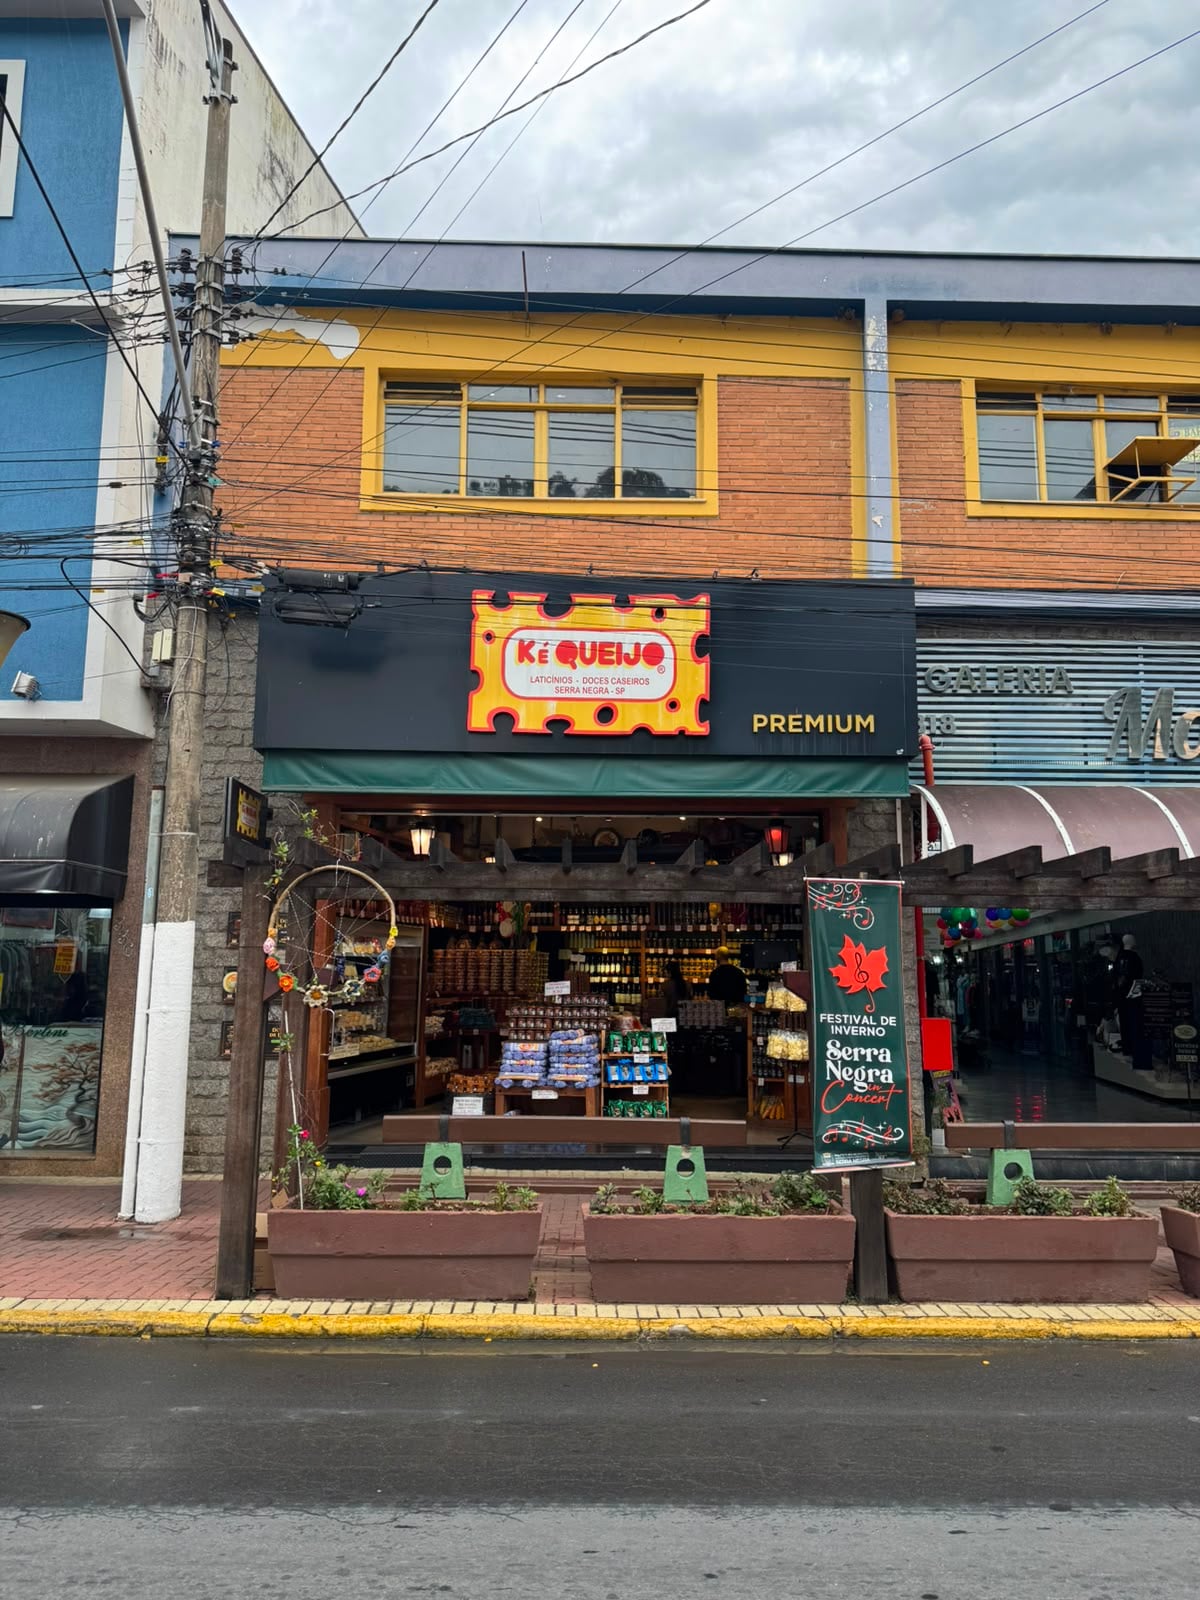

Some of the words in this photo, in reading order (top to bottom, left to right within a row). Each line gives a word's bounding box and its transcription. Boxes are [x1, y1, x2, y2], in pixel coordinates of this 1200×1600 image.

[555, 640, 665, 670] QUEIJO
[530, 675, 573, 684] LATICÍNIOS
[582, 676, 609, 685] DOCES
[611, 677, 650, 686] CASEIROS
[924, 665, 1074, 693] GALERIA
[582, 687, 609, 695] NEGRA
[752, 714, 875, 733] PREMIUM
[820, 1013, 877, 1025] FESTIVAL
[880, 1016, 897, 1026] DE
[831, 1025, 886, 1037] INVERNO
[826, 1039, 892, 1063] Serra
[825, 1059, 894, 1093] Negra
[820, 1079, 904, 1115] Concert
